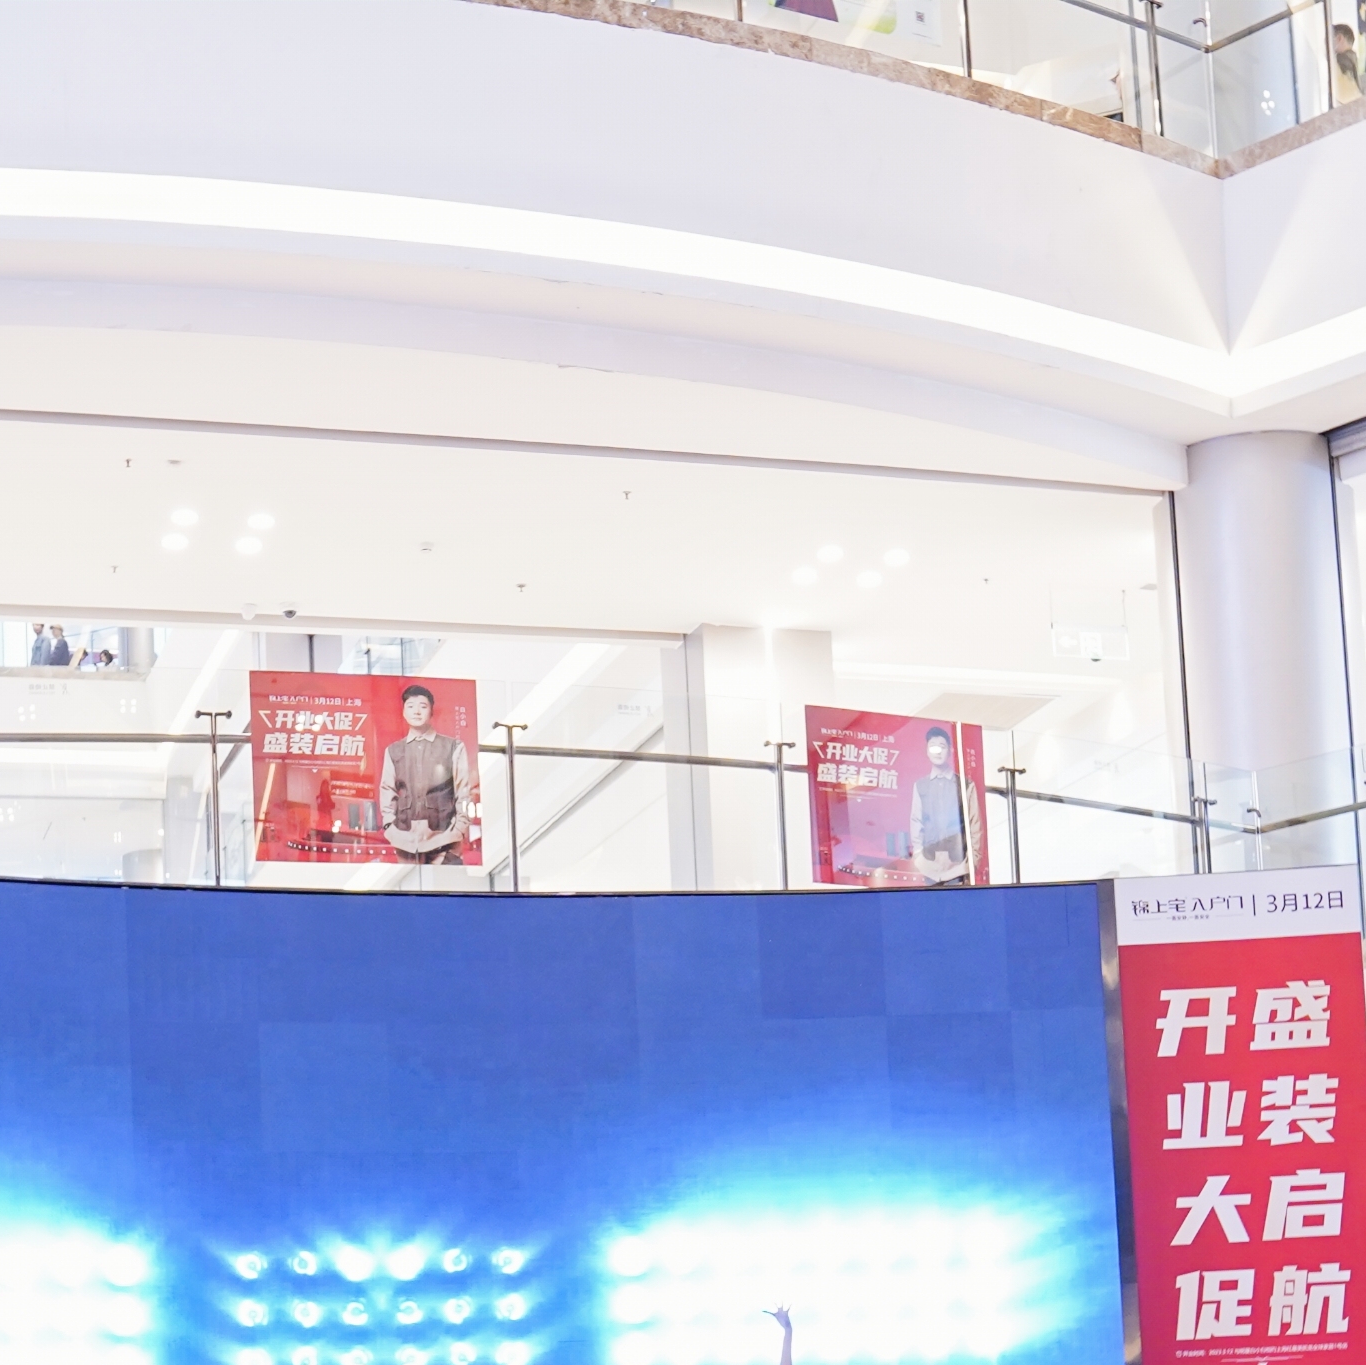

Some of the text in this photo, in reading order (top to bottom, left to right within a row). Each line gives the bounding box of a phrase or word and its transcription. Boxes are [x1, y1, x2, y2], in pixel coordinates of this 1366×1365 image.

[262, 732, 365, 757] 盛装启航
[826, 741, 888, 765] 开业大促
[817, 762, 899, 789] 盛装启航
[1266, 890, 1344, 913] 3月12日
[1155, 986, 1255, 1341] 开业大促
[1249, 980, 1351, 1337] 盛装启航
